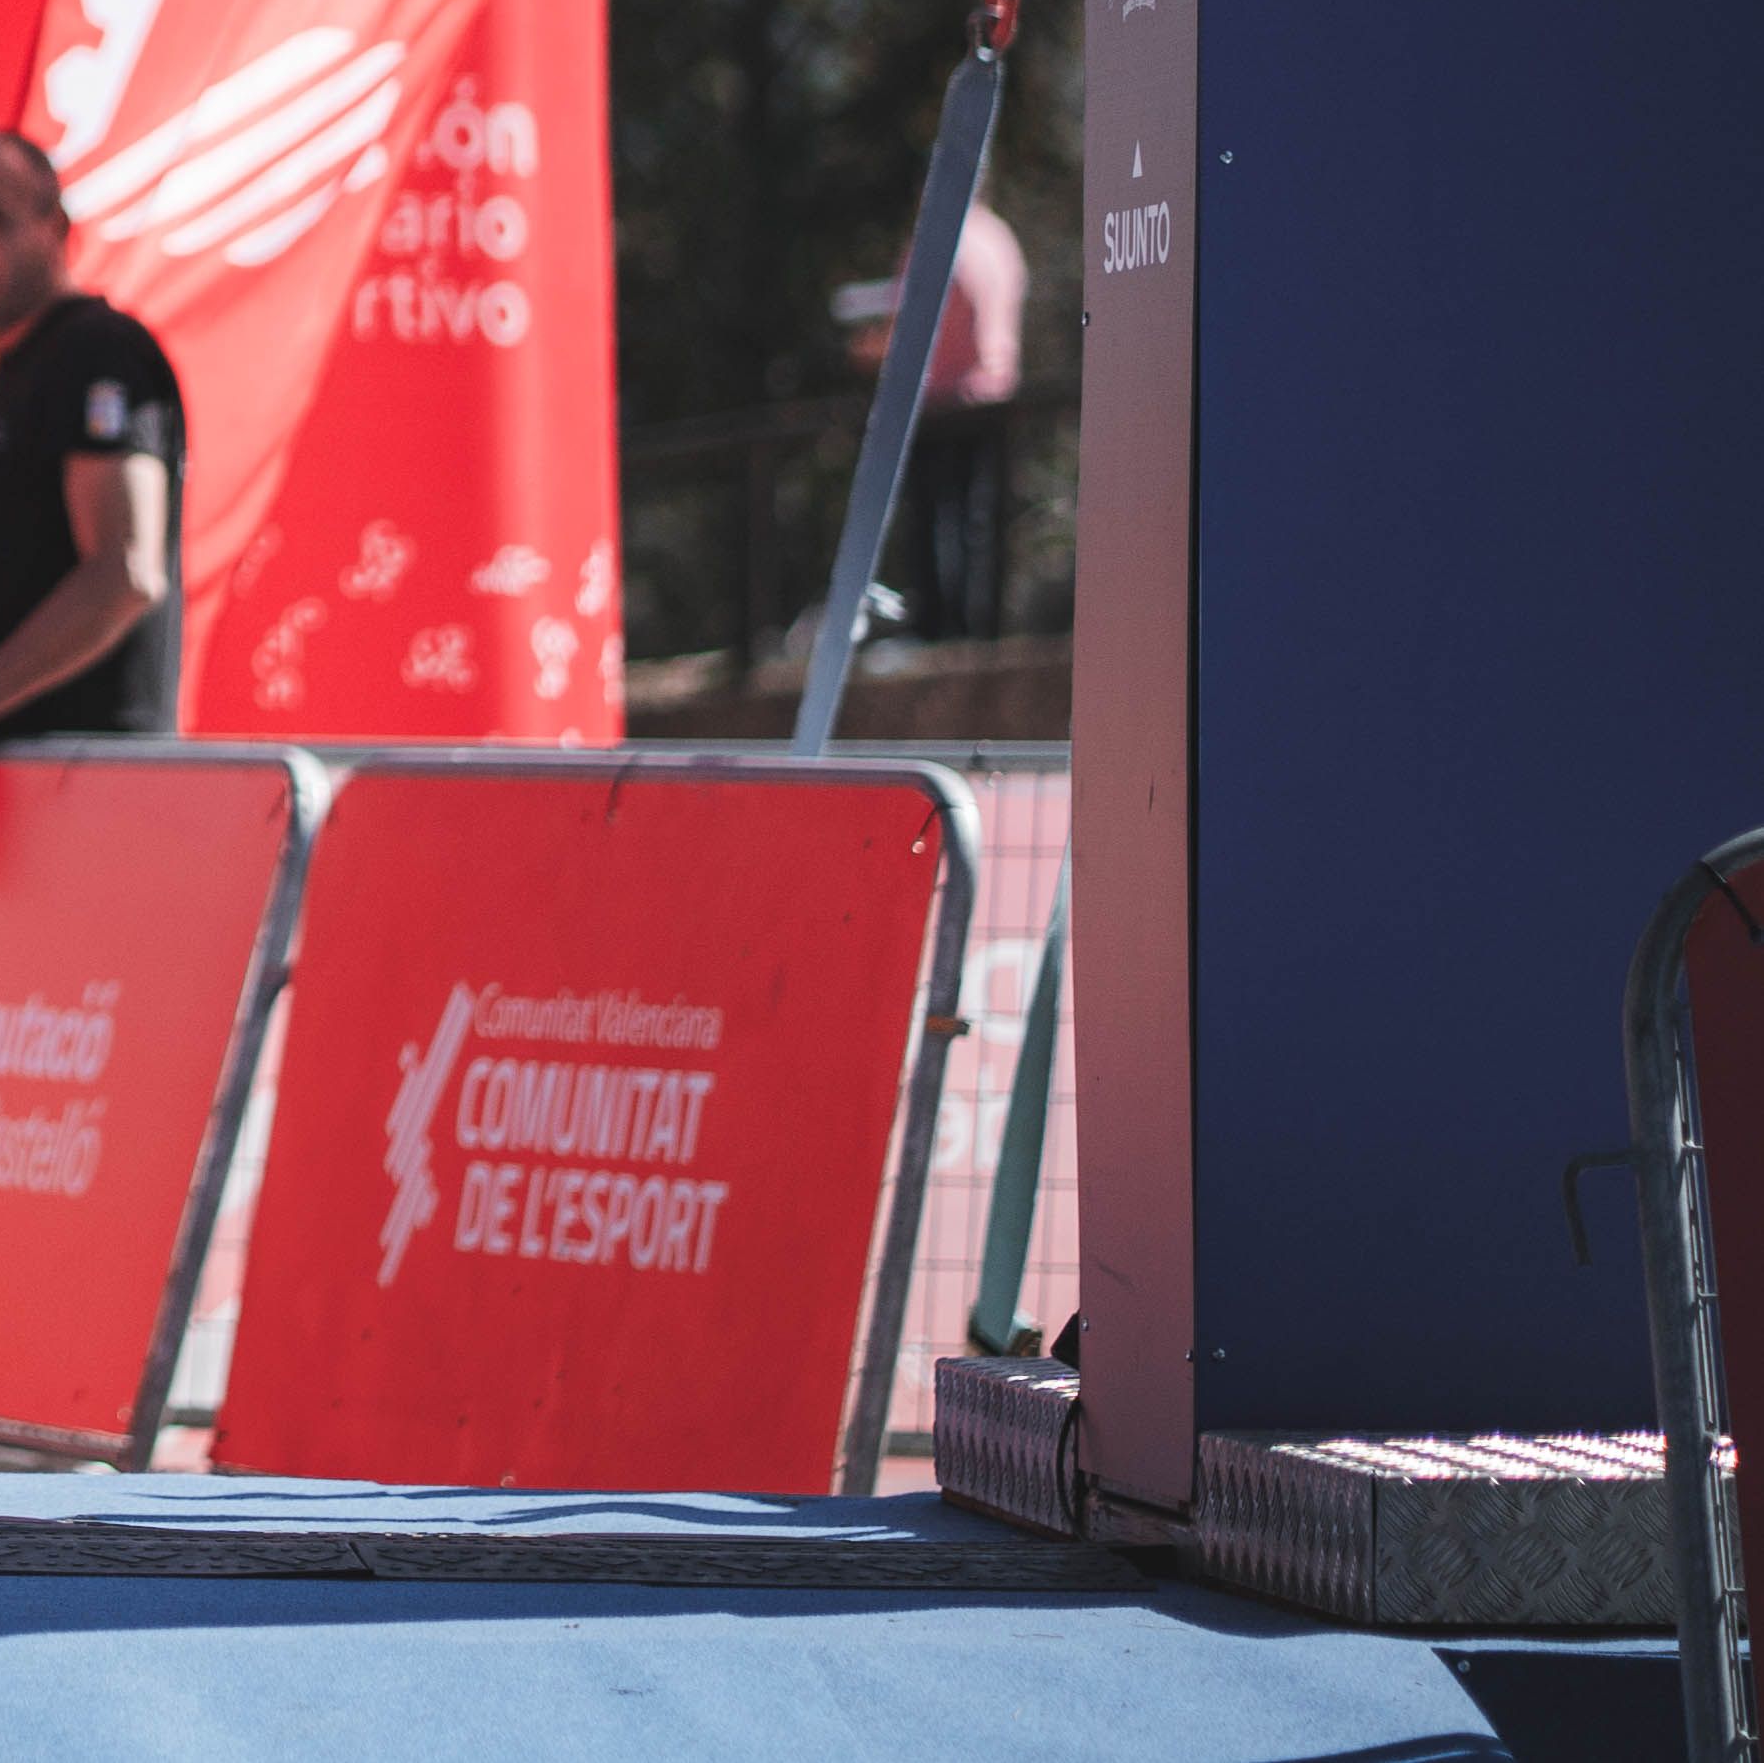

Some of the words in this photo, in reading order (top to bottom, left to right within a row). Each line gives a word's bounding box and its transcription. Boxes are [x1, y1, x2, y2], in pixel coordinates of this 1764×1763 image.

[1104, 201, 1170, 274] SUUNTO
[456, 1057, 715, 1166] COMUNITAT
[454, 1160, 518, 1255] DE
[521, 1165, 729, 1275] L'ESPORT
